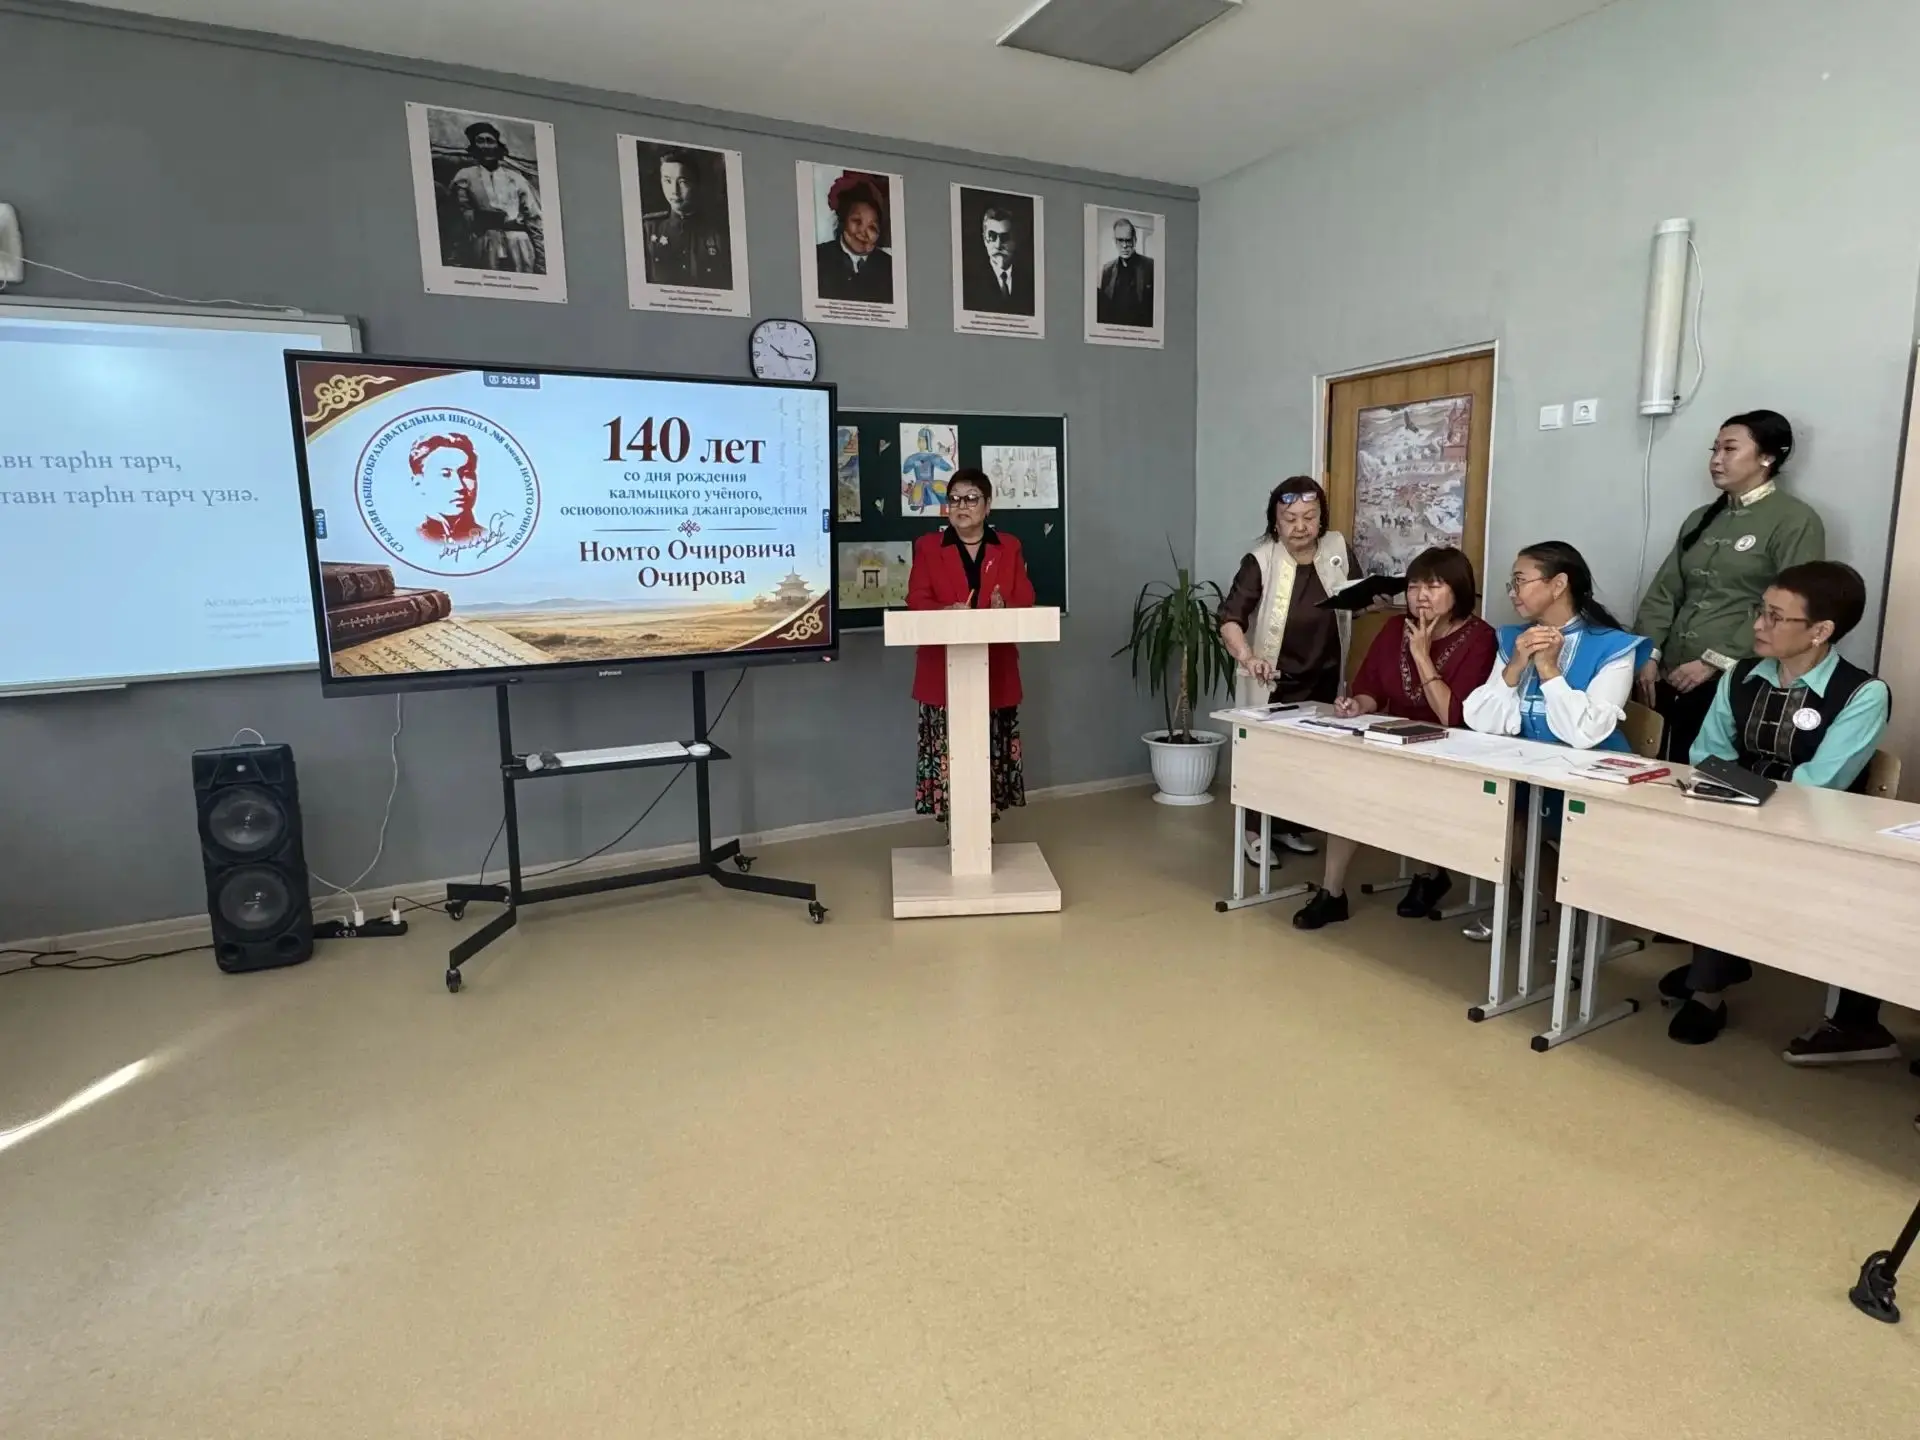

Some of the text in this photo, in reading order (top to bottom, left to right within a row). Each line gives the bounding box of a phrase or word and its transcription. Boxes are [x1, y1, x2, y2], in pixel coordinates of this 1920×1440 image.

[502, 376, 536, 386] 262 554
[449, 414, 488, 433] ШКОЛА
[603, 416, 766, 464] 140 лет
[0, 455, 33, 469] вн
[363, 414, 446, 507] ОБЩЕОБРАЗОВАТЕЛЬНАЯ
[504, 442, 523, 467] имени
[520, 467, 534, 505] НОМТО
[624, 472, 747, 485] со дня рождения
[140, 490, 195, 507] тарч
[609, 486, 763, 502] калмыцкого учёного,
[560, 506, 808, 518] основоположника джангароведения
[368, 509, 404, 553] СРЕДНЯЯ
[506, 507, 533, 550] ОЧИРОВА
[579, 539, 796, 564] Номто Очировича
[638, 566, 746, 591] Очирова
